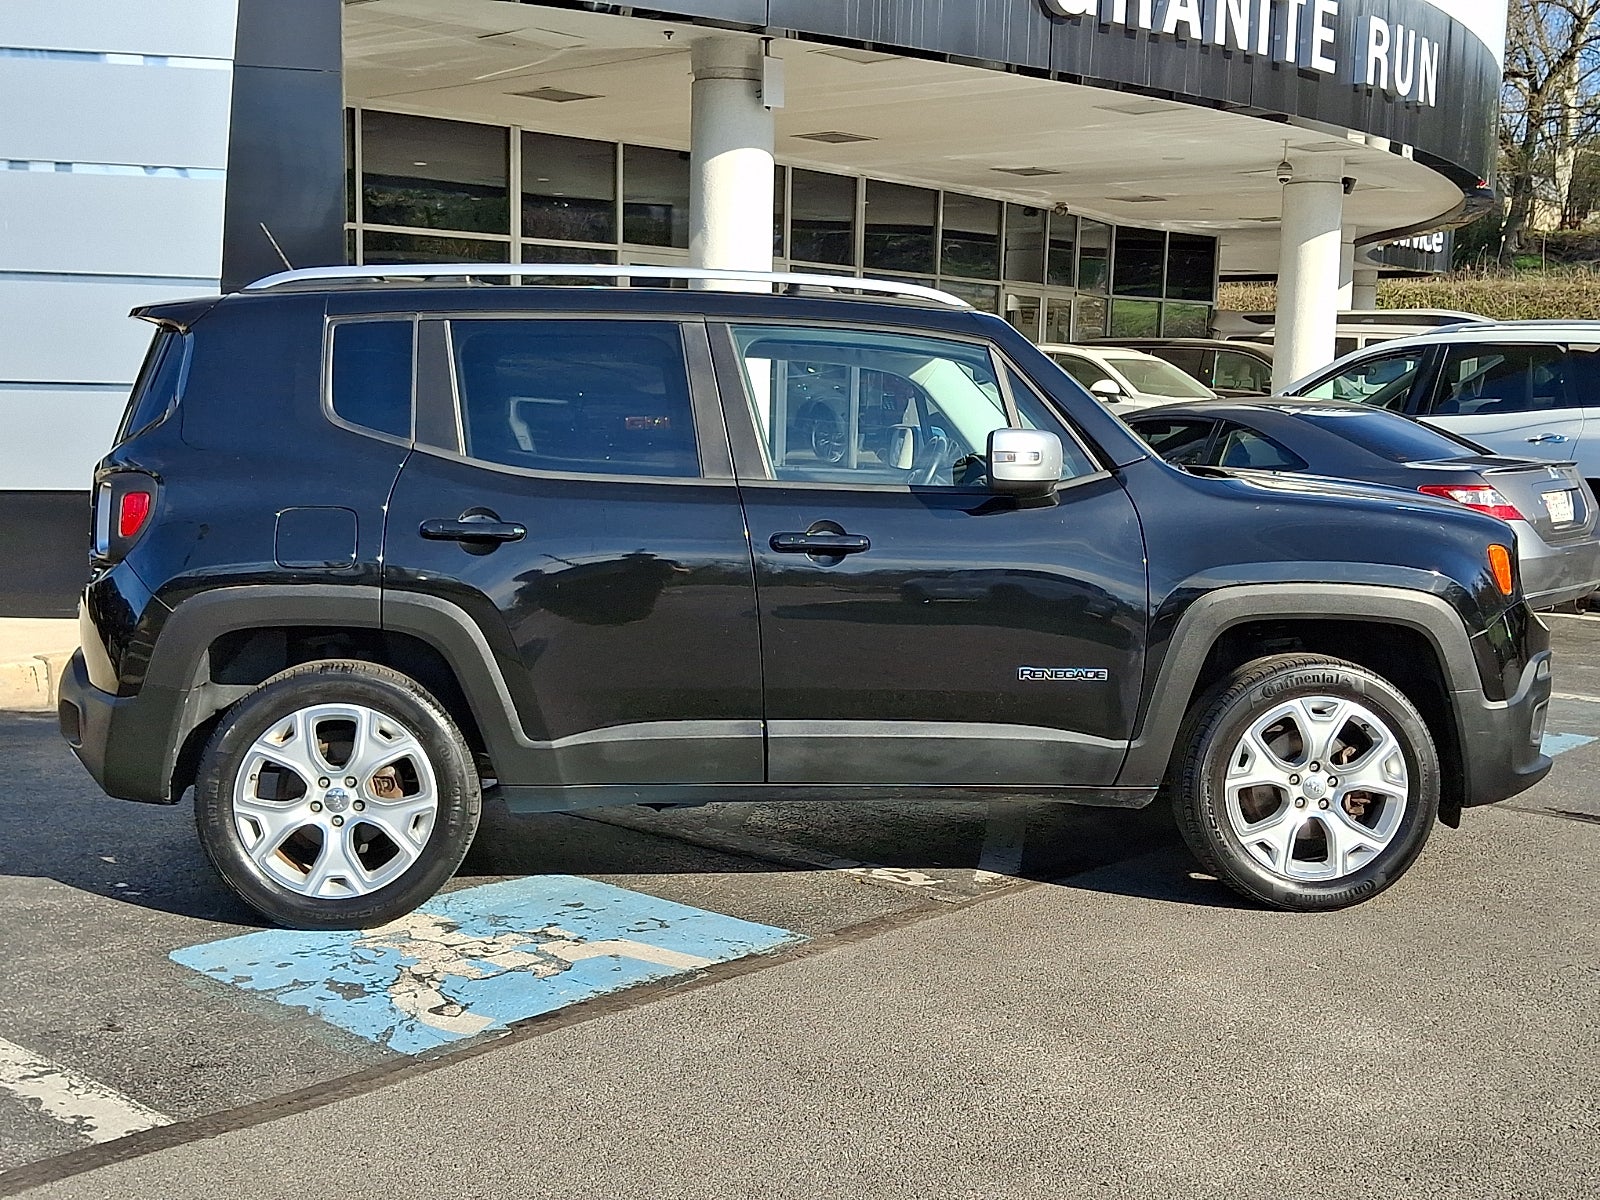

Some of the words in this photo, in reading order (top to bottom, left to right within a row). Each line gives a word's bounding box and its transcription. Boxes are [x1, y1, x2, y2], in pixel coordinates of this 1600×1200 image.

[1056, 0, 1338, 74] ANITE
[1366, 15, 1439, 108] RUN
[1018, 667, 1108, 681] RENEGADE
[1261, 672, 1340, 699] Continental
